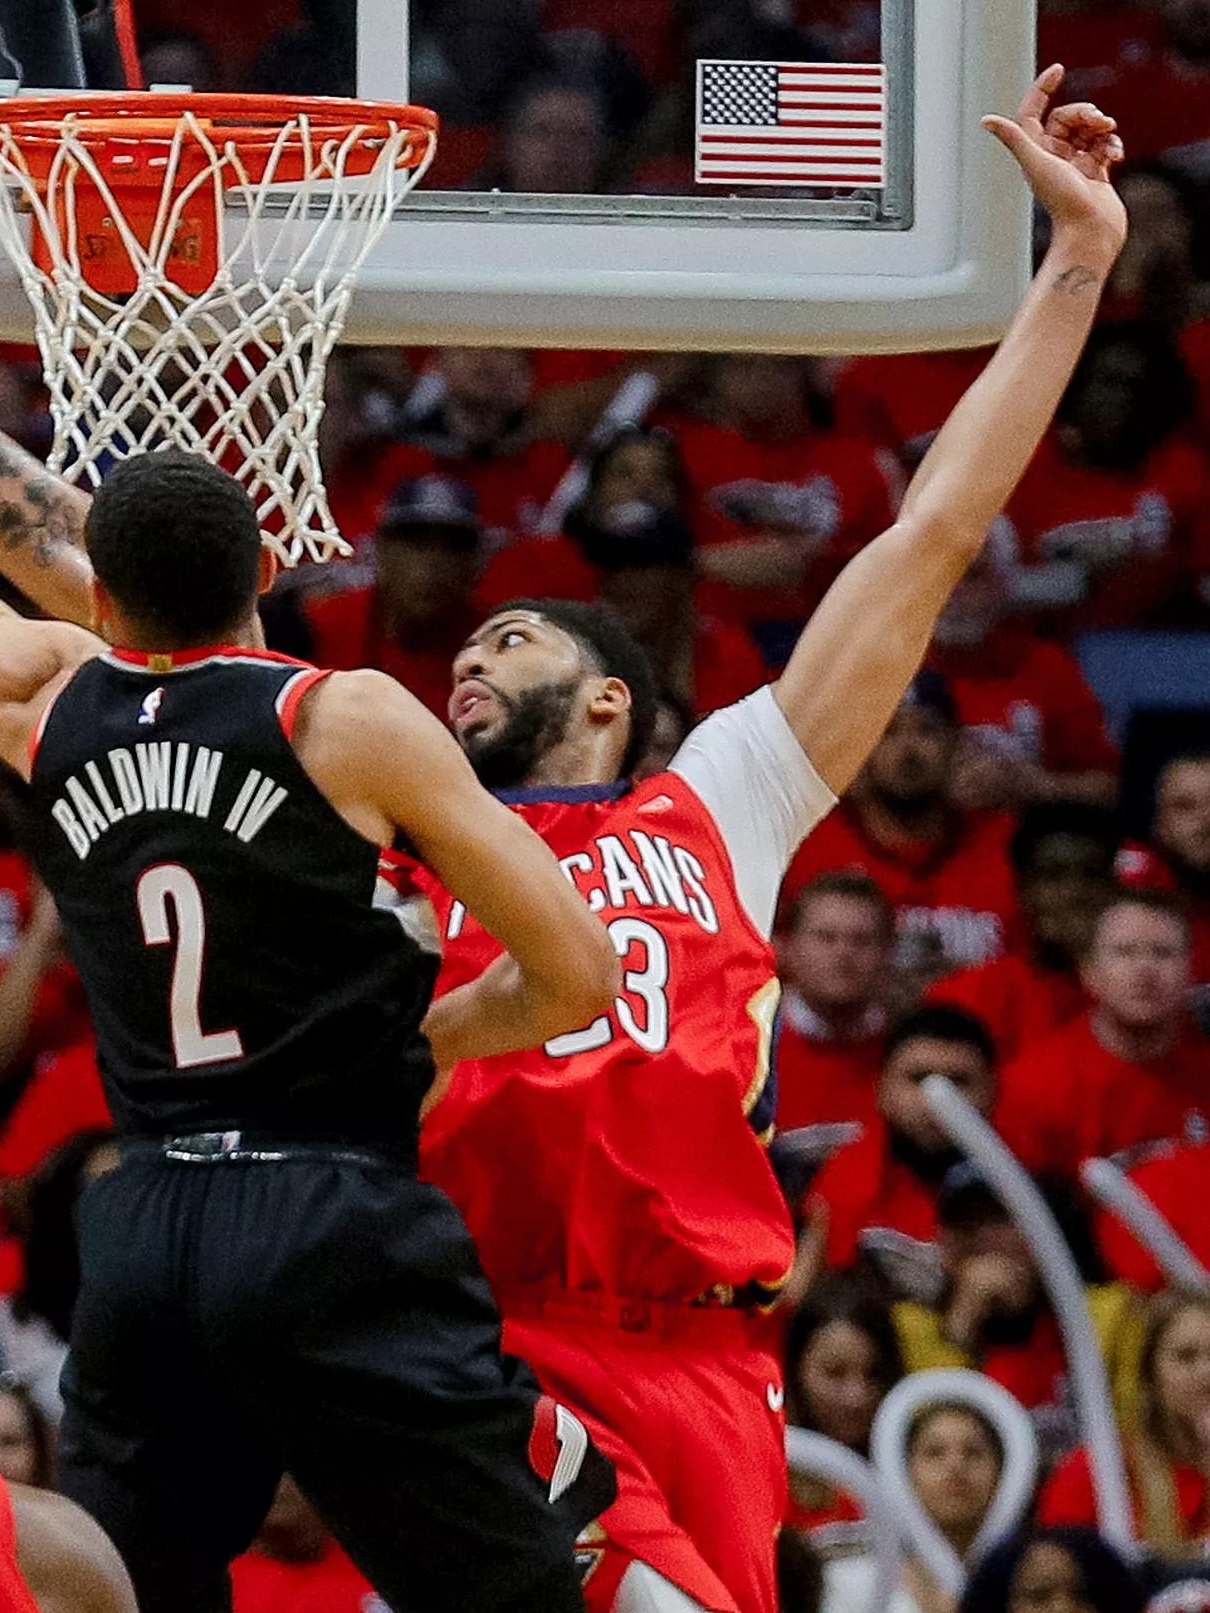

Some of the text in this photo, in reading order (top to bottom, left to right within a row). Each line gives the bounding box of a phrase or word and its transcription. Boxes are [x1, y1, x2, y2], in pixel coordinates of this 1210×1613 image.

[51, 741, 289, 861] BALDWIN IV
[136, 861, 244, 1069] 2
[544, 916, 669, 1057] 3
